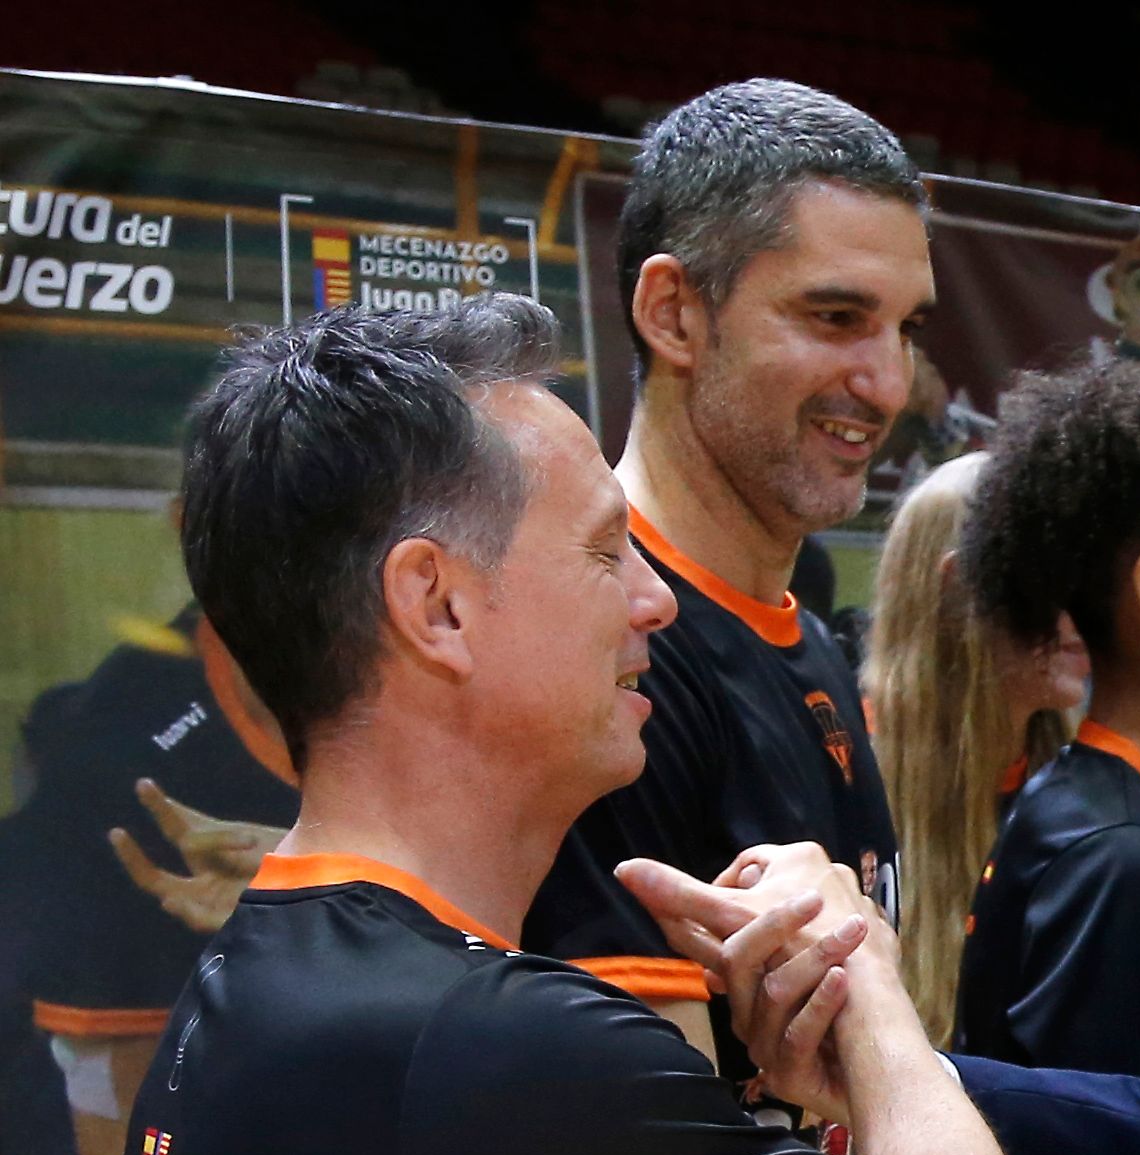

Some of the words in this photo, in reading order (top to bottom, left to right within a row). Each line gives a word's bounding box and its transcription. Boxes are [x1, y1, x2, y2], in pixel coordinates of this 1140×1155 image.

[115, 213, 173, 248] del
[358, 234, 509, 265] MECENAZGO
[358, 256, 496, 287] DEPORTIVO
